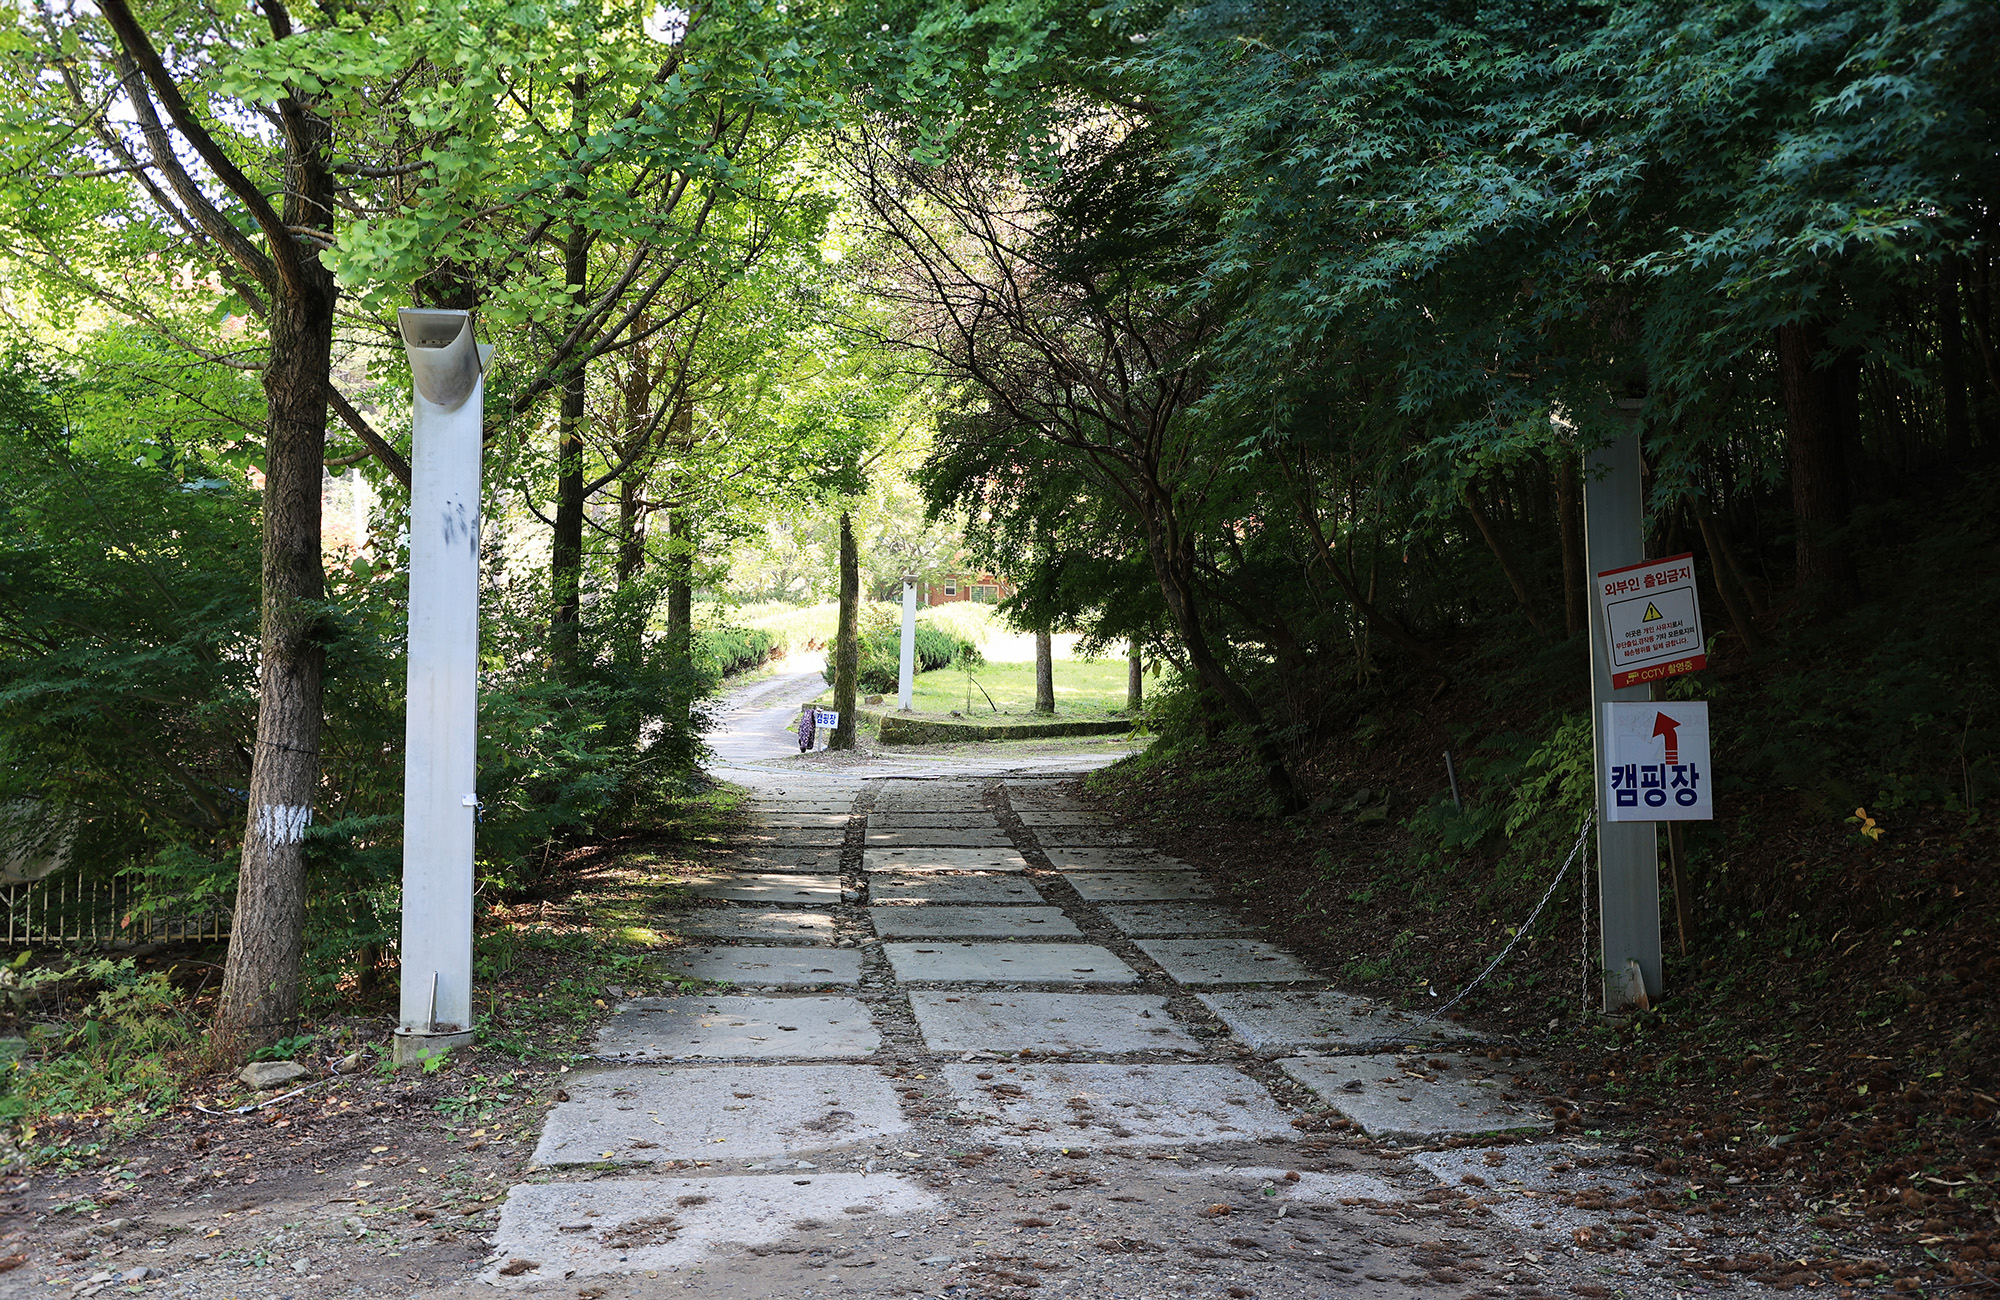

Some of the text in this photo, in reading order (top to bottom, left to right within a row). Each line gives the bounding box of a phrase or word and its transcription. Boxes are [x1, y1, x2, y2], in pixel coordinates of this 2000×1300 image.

[1605, 566, 1691, 595] 외부인 출입금지
[1625, 629, 1642, 639] 이곳은
[1643, 626, 1655, 634] 개인
[1655, 633, 1667, 641] 기타
[1641, 660, 1693, 680] CCTV 촬영중
[816, 713, 837, 725] 캠핑장
[1611, 762, 1700, 807] 캠핑장
